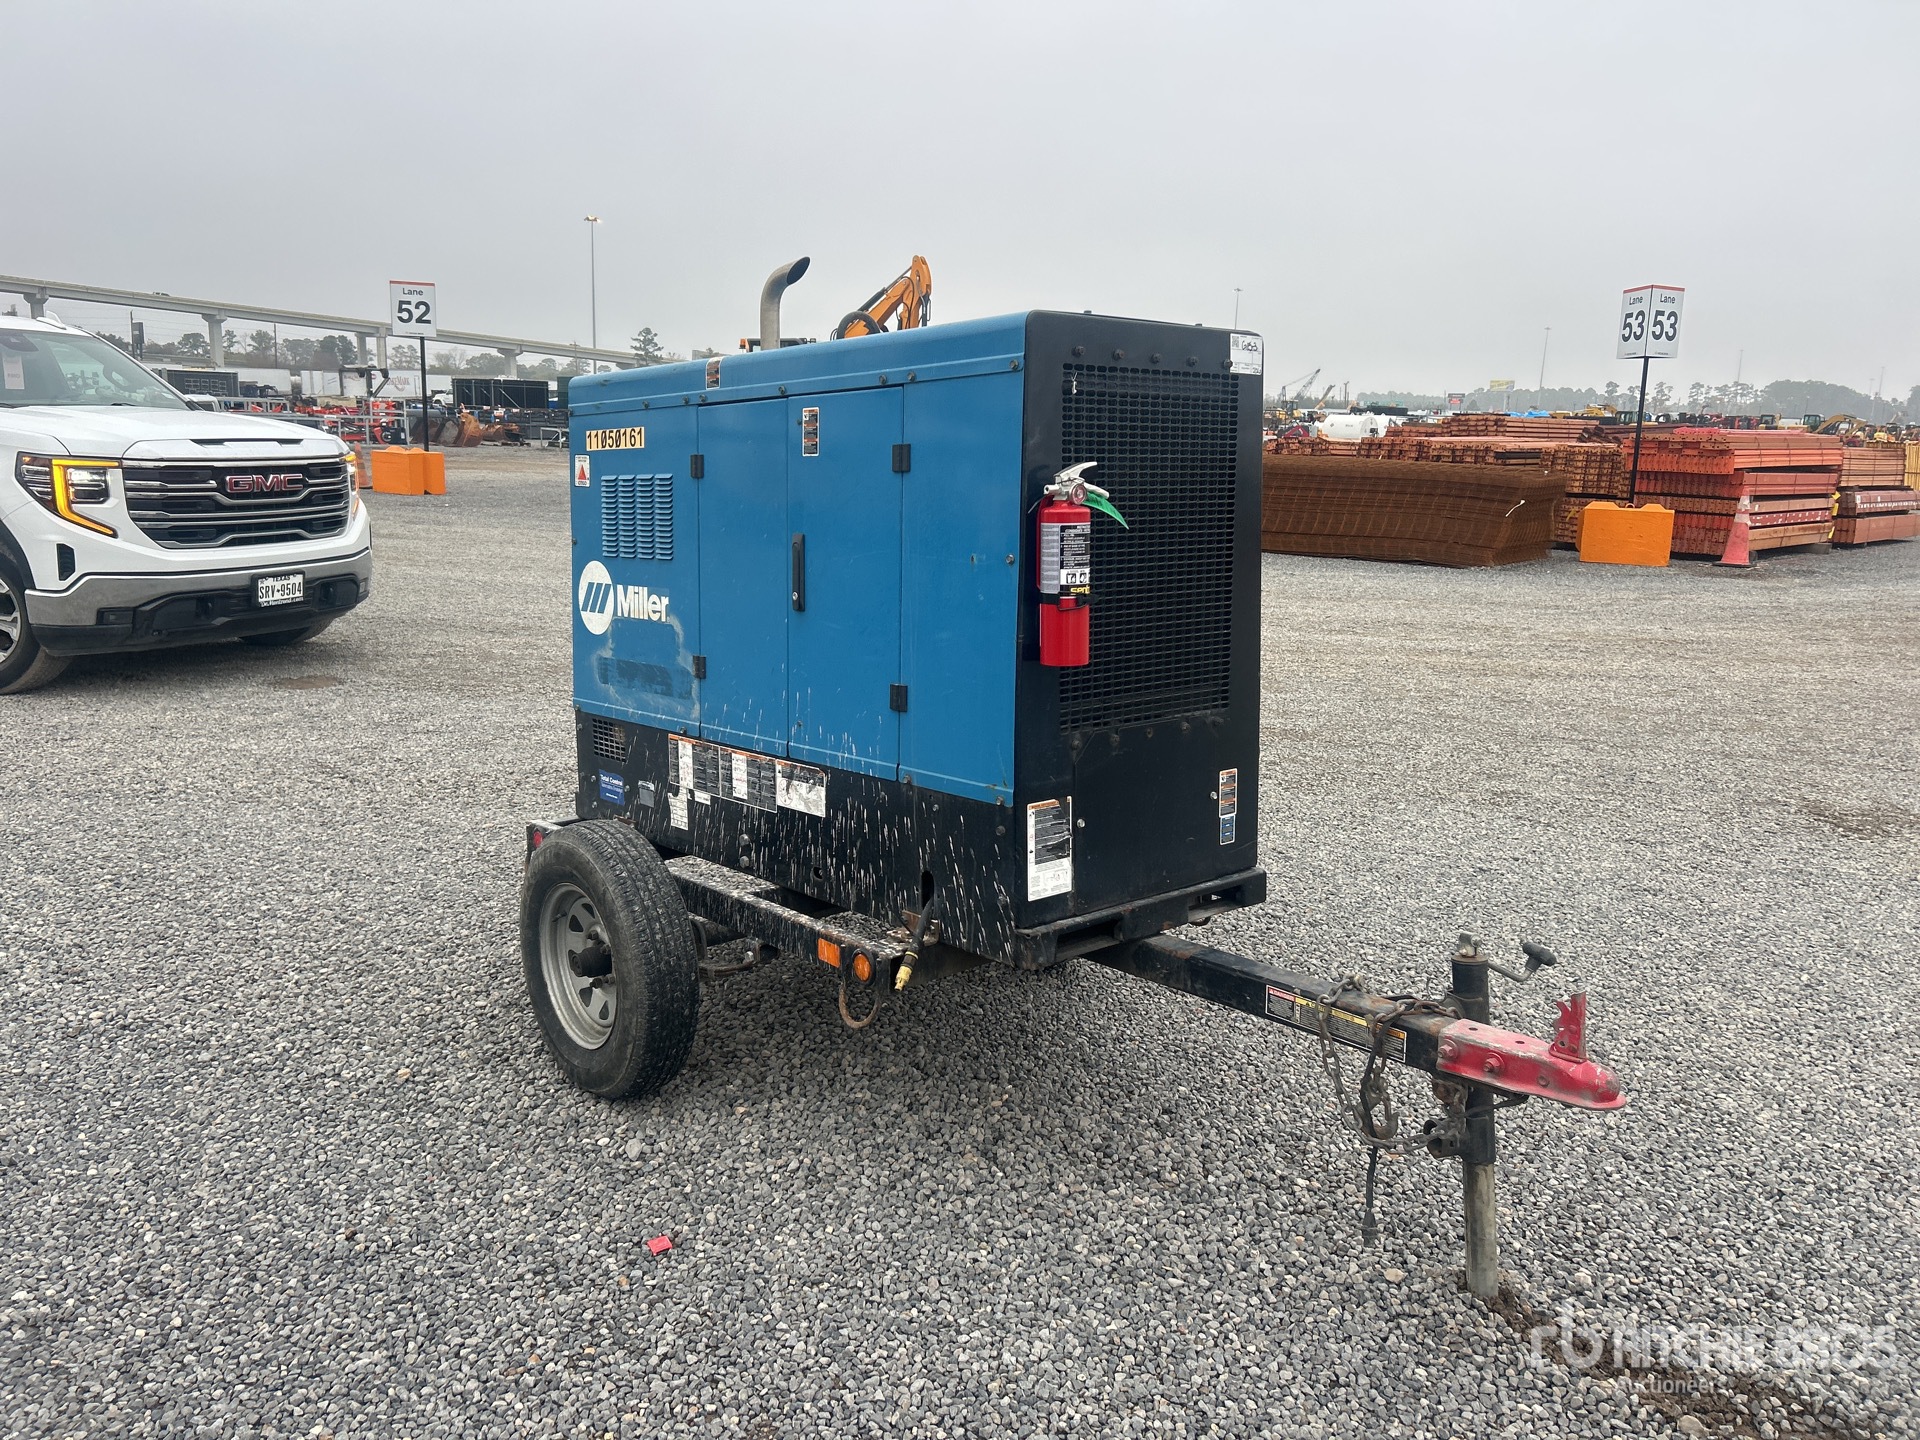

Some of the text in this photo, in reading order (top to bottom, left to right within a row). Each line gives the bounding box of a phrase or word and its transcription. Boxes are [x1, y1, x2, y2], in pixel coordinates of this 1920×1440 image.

[402, 287, 424, 296] Lane
[1629, 296, 1643, 305] Lane
[1660, 293, 1676, 304] Lane
[397, 300, 432, 325] 52
[1622, 310, 1646, 343] 53
[1652, 310, 1679, 342] 53
[587, 427, 642, 449] 11050161
[225, 473, 304, 493] GMC
[616, 584, 670, 622] Miller
